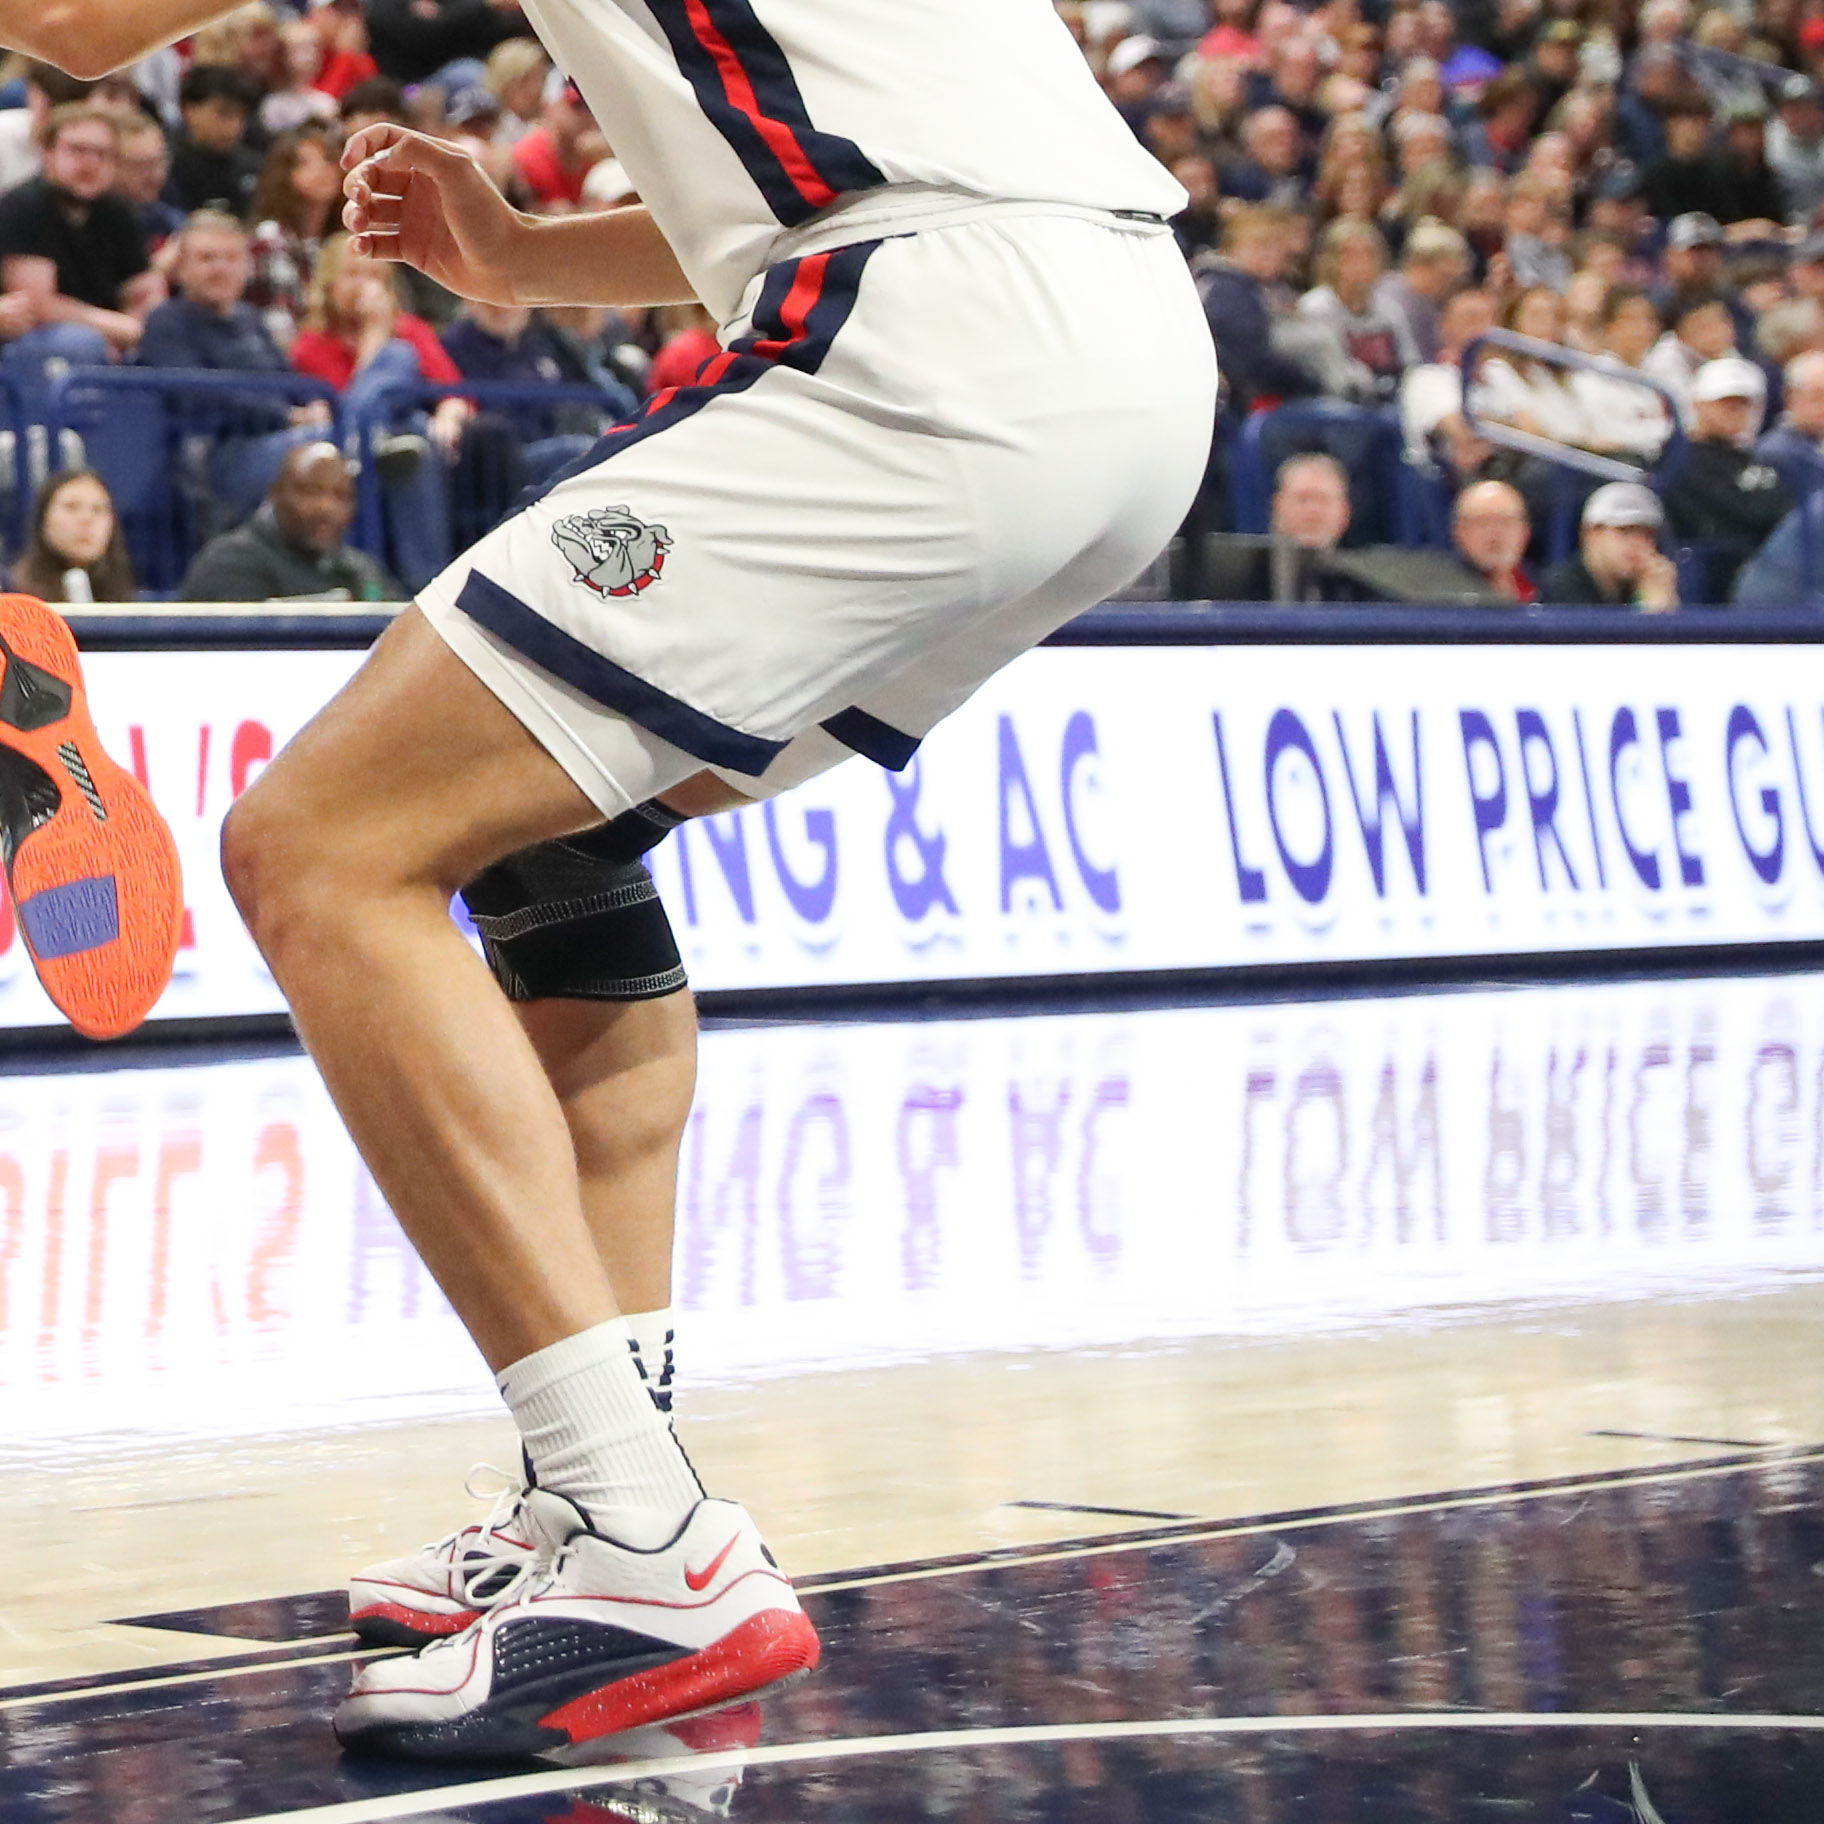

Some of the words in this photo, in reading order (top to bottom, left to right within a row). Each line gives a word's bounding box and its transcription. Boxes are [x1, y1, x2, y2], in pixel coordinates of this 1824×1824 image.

[884, 748, 963, 922] &
[997, 709, 1121, 915] AC
[1212, 706, 1428, 904] LOW
[1458, 705, 1705, 892] PRICE
